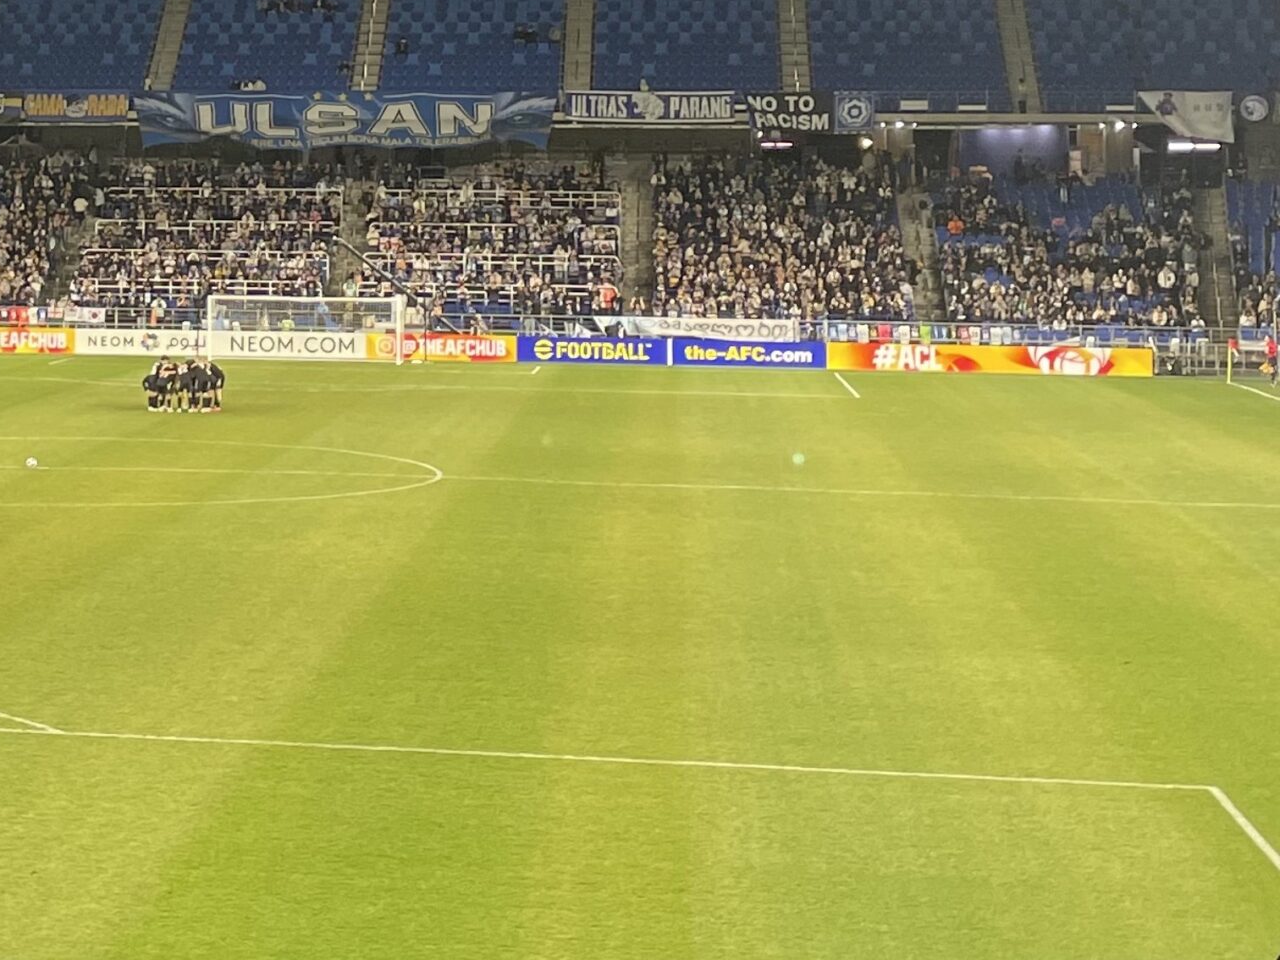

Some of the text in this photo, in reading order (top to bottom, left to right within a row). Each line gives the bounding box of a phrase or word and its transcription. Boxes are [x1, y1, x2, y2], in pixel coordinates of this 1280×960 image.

[571, 95, 731, 119] ULTRAS PARANG
[747, 95, 815, 113] NO TO
[194, 100, 496, 139] ULSAN
[754, 111, 829, 131] RACISM
[88, 335, 135, 348] NEOM
[230, 336, 355, 353] NEOM.COM
[684, 345, 812, 363] the-AFC.com
